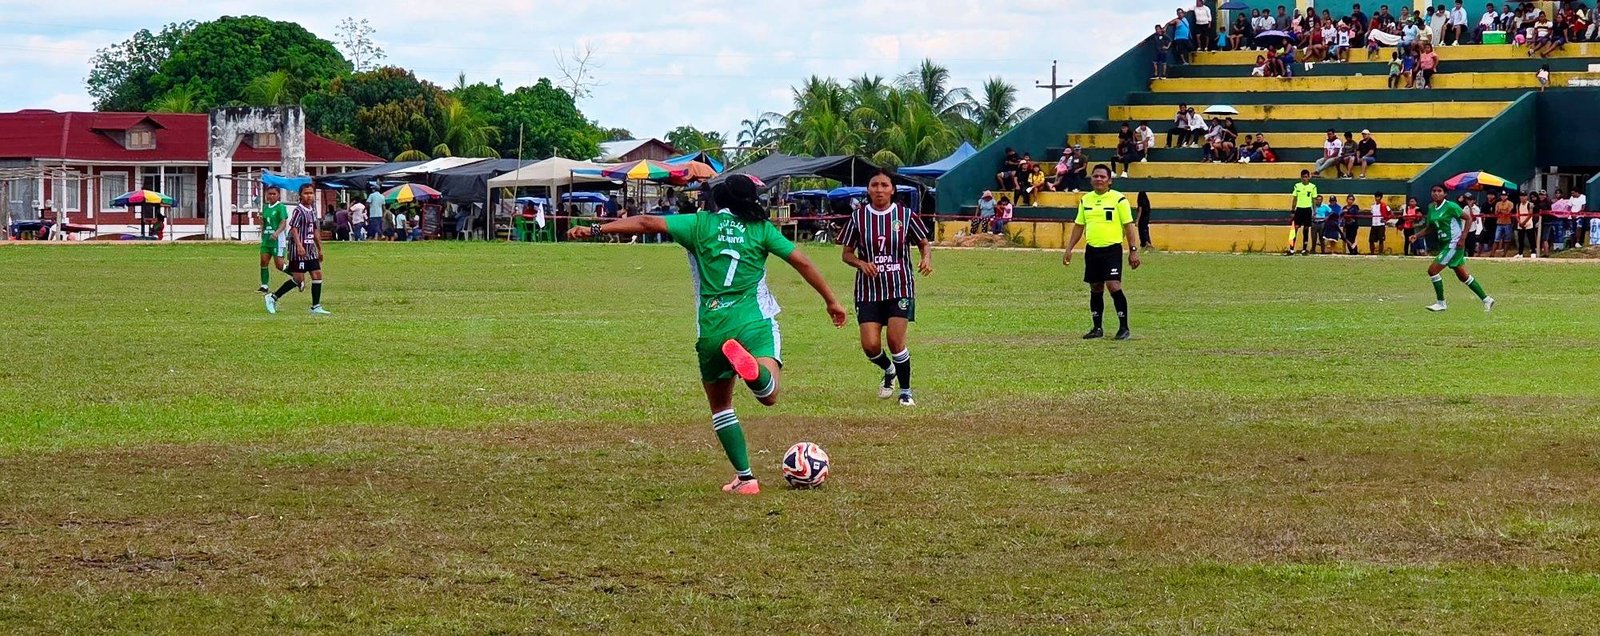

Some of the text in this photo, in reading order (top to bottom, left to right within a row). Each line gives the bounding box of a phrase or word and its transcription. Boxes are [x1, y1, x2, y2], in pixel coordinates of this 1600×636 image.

[877, 235, 887, 252] 7
[874, 255, 893, 264] COPA
[719, 248, 741, 287] 7
[886, 263, 901, 272] SUR
